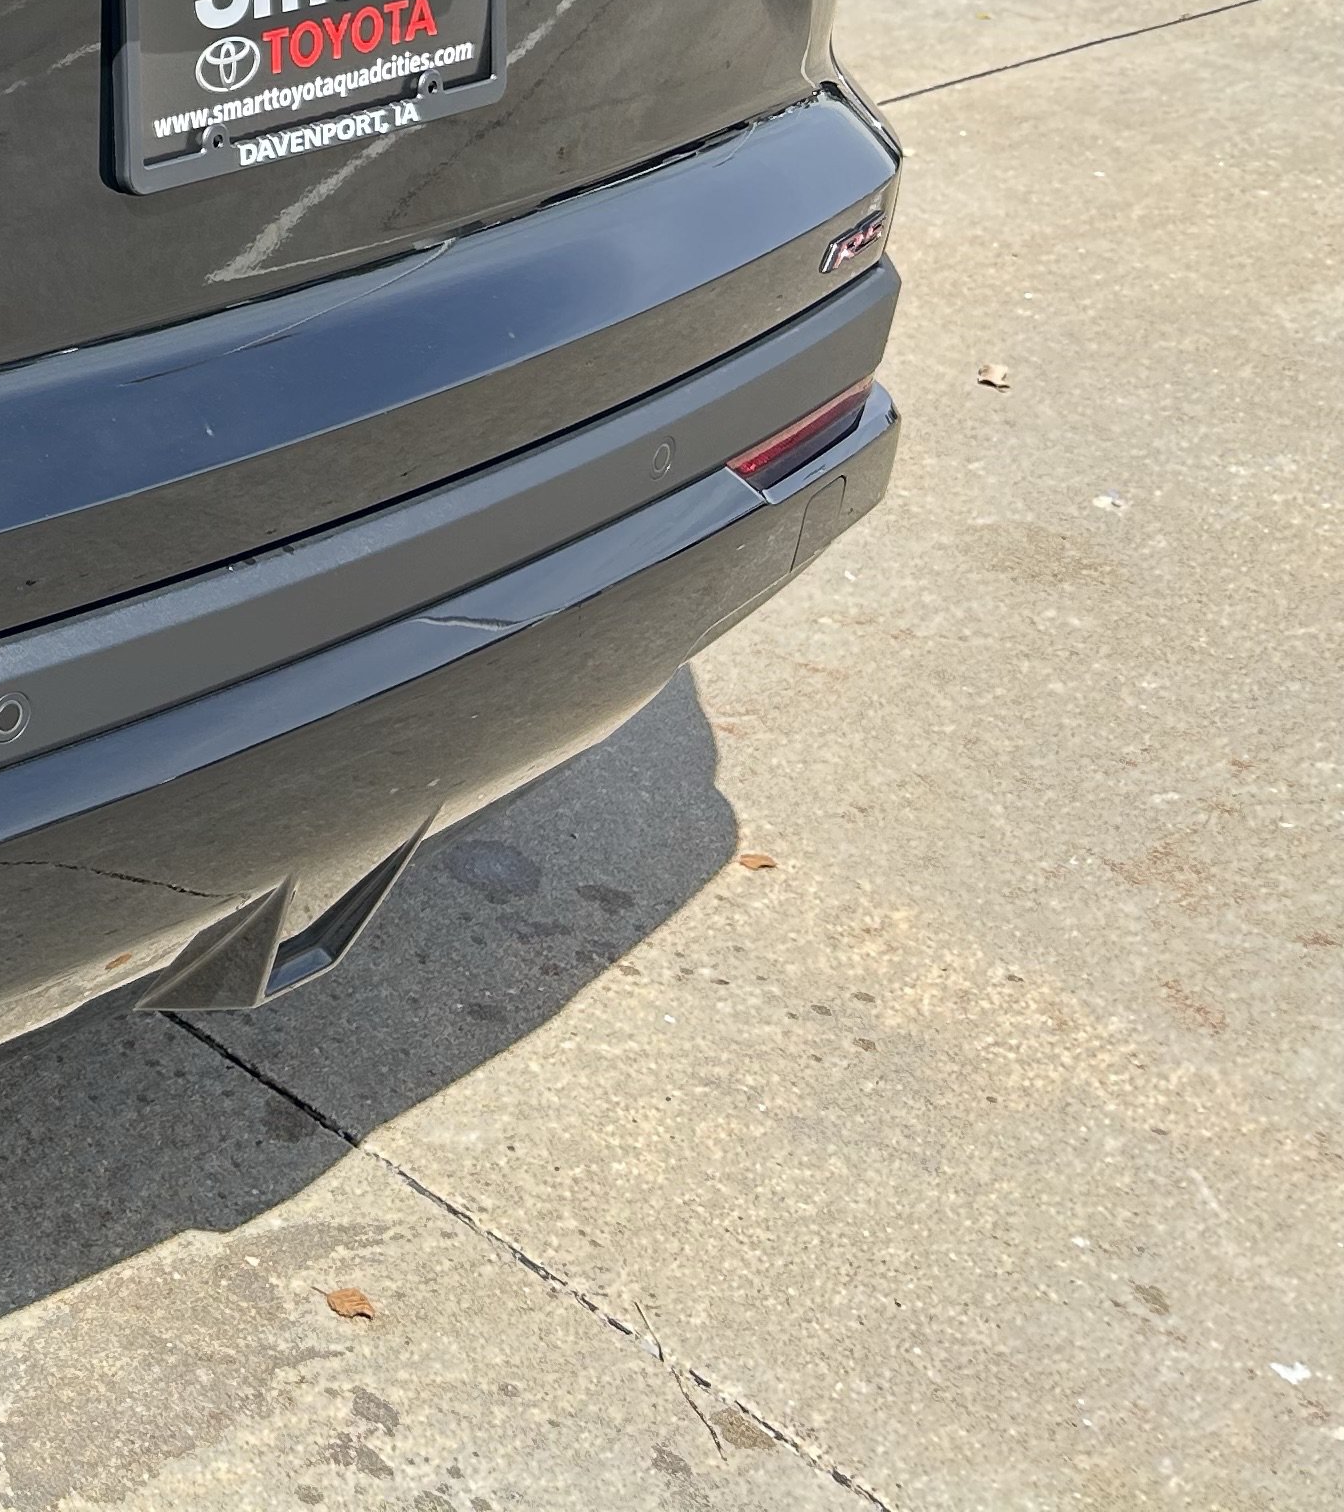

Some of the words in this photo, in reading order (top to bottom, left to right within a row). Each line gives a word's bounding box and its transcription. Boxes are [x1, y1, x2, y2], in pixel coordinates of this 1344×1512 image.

[153, 40, 473, 138] www.smarttoyotaquadcities.com
[239, 112, 389, 167] DAVENPORT,
[394, 101, 420, 126] IA
